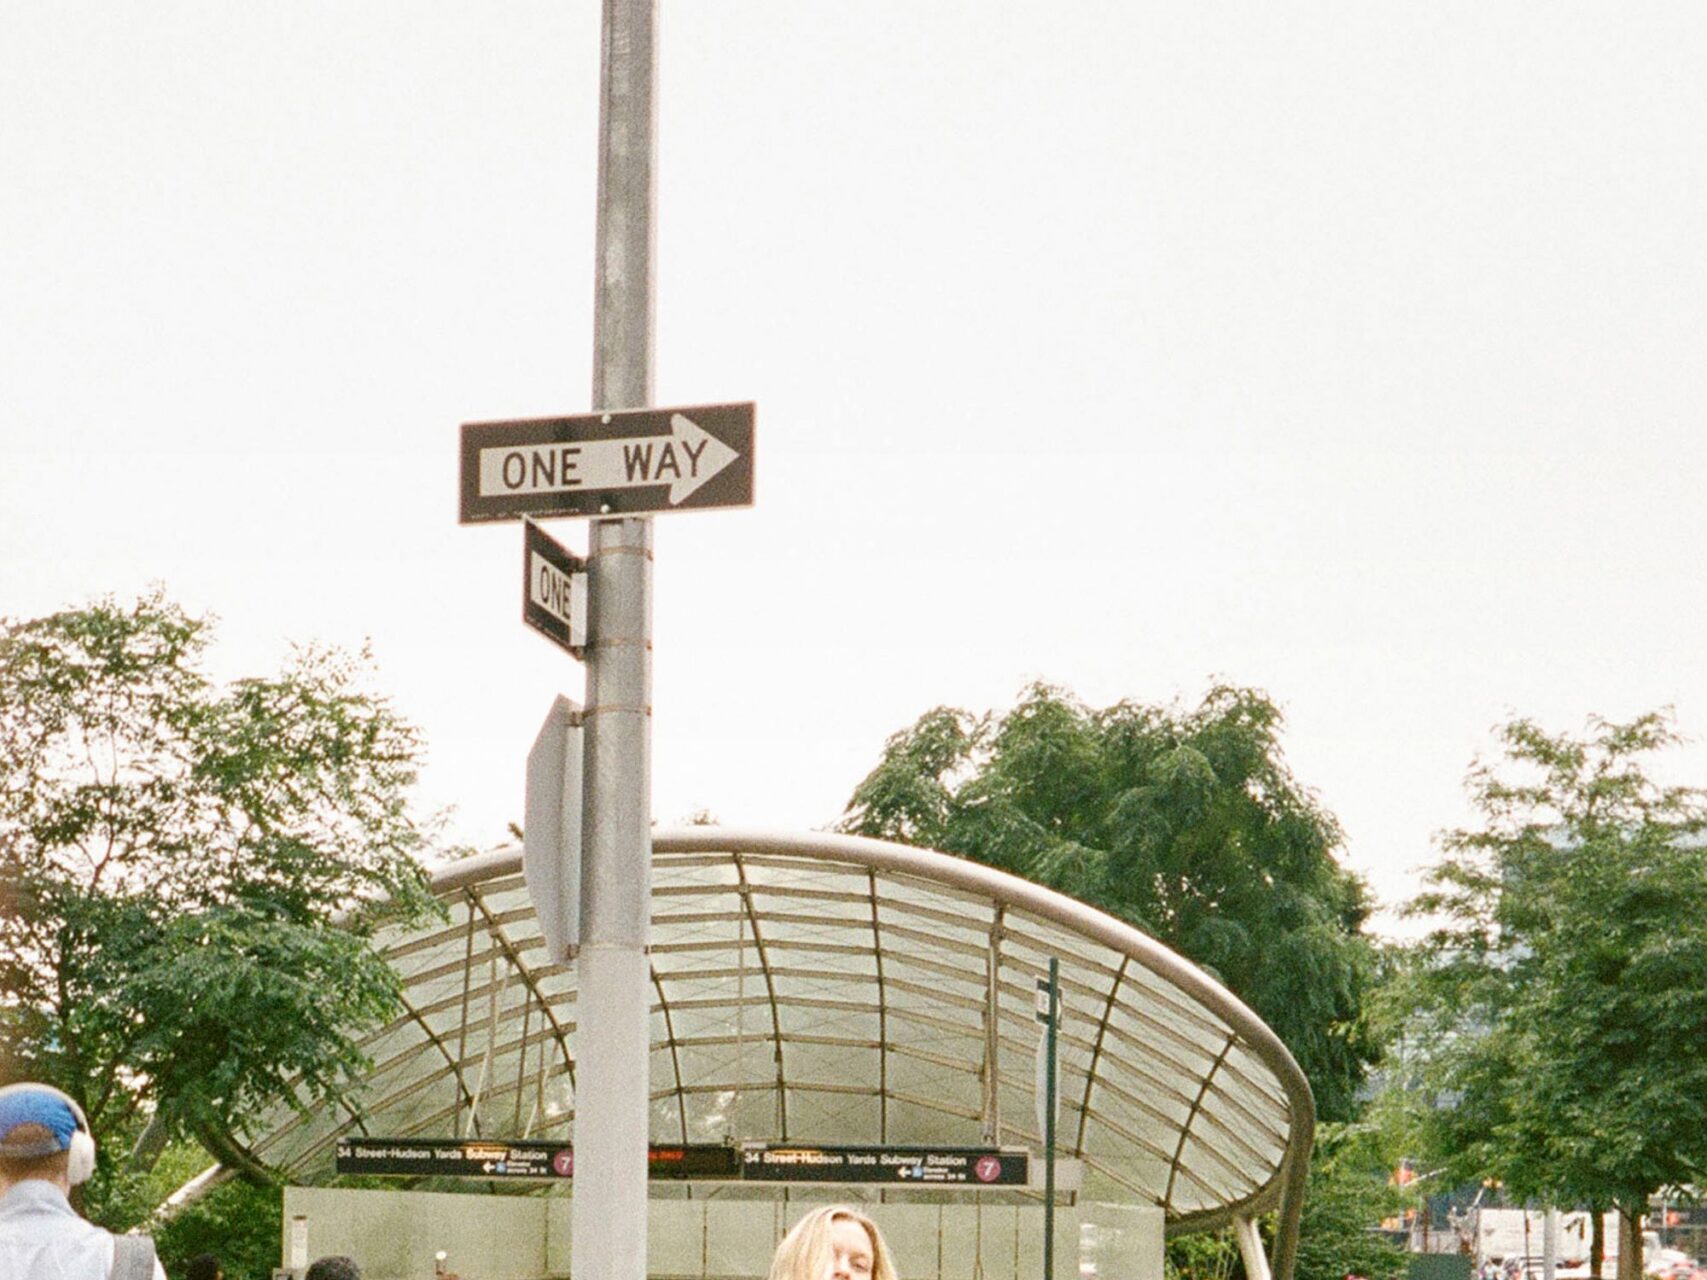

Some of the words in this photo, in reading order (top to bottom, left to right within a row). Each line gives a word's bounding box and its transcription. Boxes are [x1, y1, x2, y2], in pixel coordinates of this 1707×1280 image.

[503, 448, 582, 490] ONE
[624, 439, 709, 482] WAY
[540, 564, 571, 620] ONE
[337, 1147, 351, 1158] 34
[355, 1148, 431, 1159] Street-Hudson
[434, 1148, 462, 1159] Yards
[466, 1147, 507, 1161] Subway
[510, 1148, 548, 1160] Station
[744, 1152, 759, 1163] 34
[763, 1152, 843, 1165] Street-Hudson
[847, 1154, 876, 1165] Yards
[880, 1154, 923, 1167] Subway
[927, 1154, 967, 1166] Station
[561, 1156, 571, 1171] 7
[983, 1161, 994, 1176] 7
